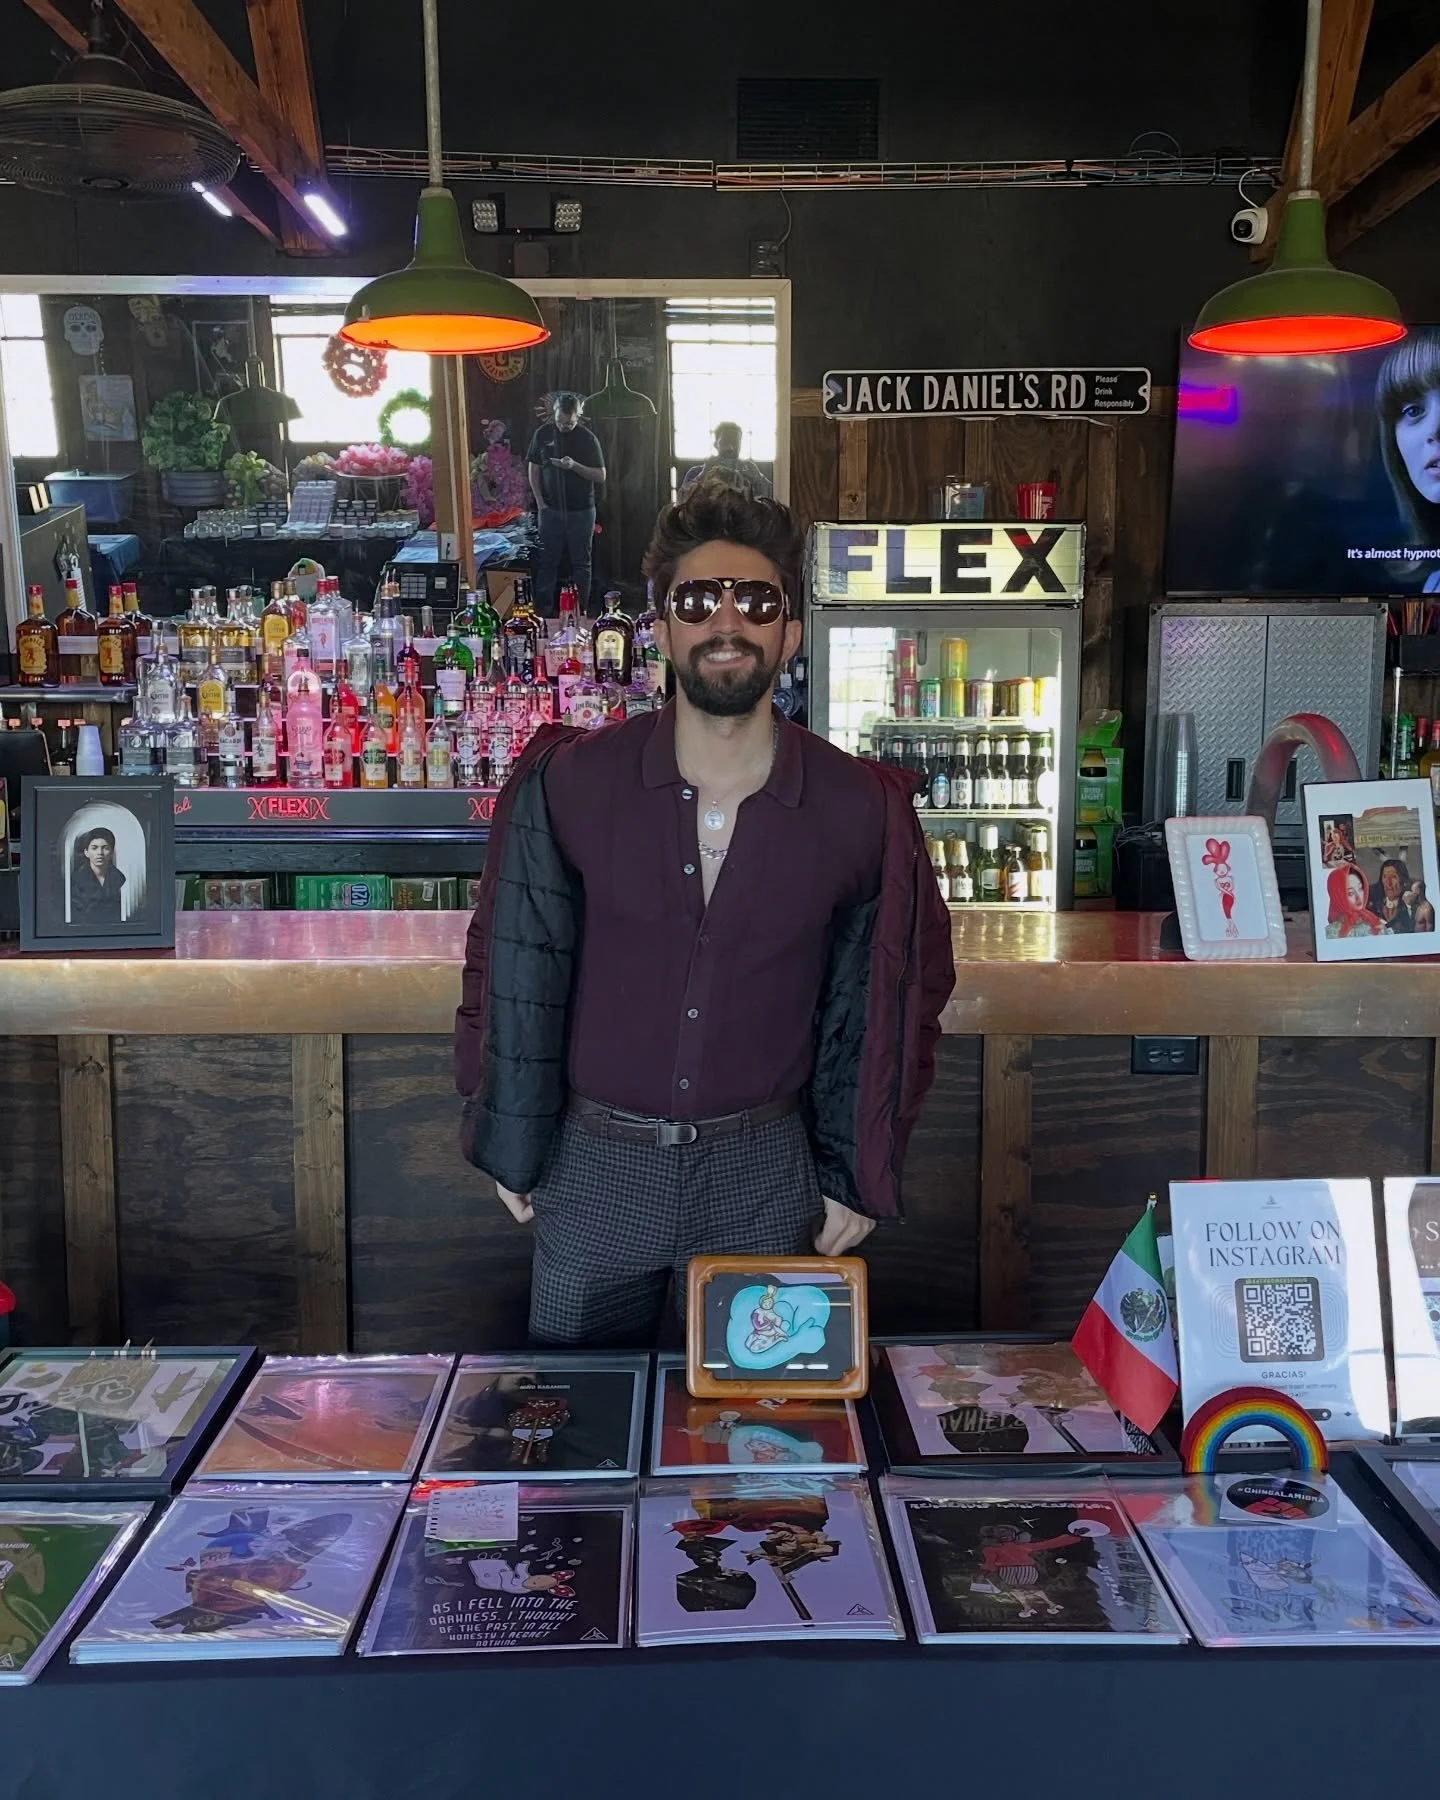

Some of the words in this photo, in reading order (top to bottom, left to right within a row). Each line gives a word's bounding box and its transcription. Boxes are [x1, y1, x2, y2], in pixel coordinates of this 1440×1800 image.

[1095, 375, 1118, 383] Please
[838, 376, 912, 412] JACK
[1051, 374, 1086, 409] RD
[1094, 400, 1134, 408] Responsibly
[1347, 548, 1362, 559] It's
[1365, 548, 1401, 559] almost
[829, 528, 1067, 594] FLEX
[1080, 793, 1105, 801] LIGHT
[1205, 1221, 1303, 1242] FOLLOW
[1310, 1220, 1342, 1240] ON
[1209, 1245, 1342, 1267] INSTAGRAM
[432, 1601, 451, 1614] AS
[457, 1600, 462, 1611] I
[469, 1598, 504, 1610] FELL
[511, 1597, 542, 1608] INTO
[551, 1597, 578, 1610] THE
[507, 1611, 513, 1621] I
[520, 1610, 577, 1622] THOUGHT
[459, 1624, 481, 1632] THE
[521, 1622, 535, 1630] IN
[538, 1622, 561, 1630] ALL
[449, 1632, 497, 1641] HONESTY
[508, 1631, 551, 1639] REGRET
